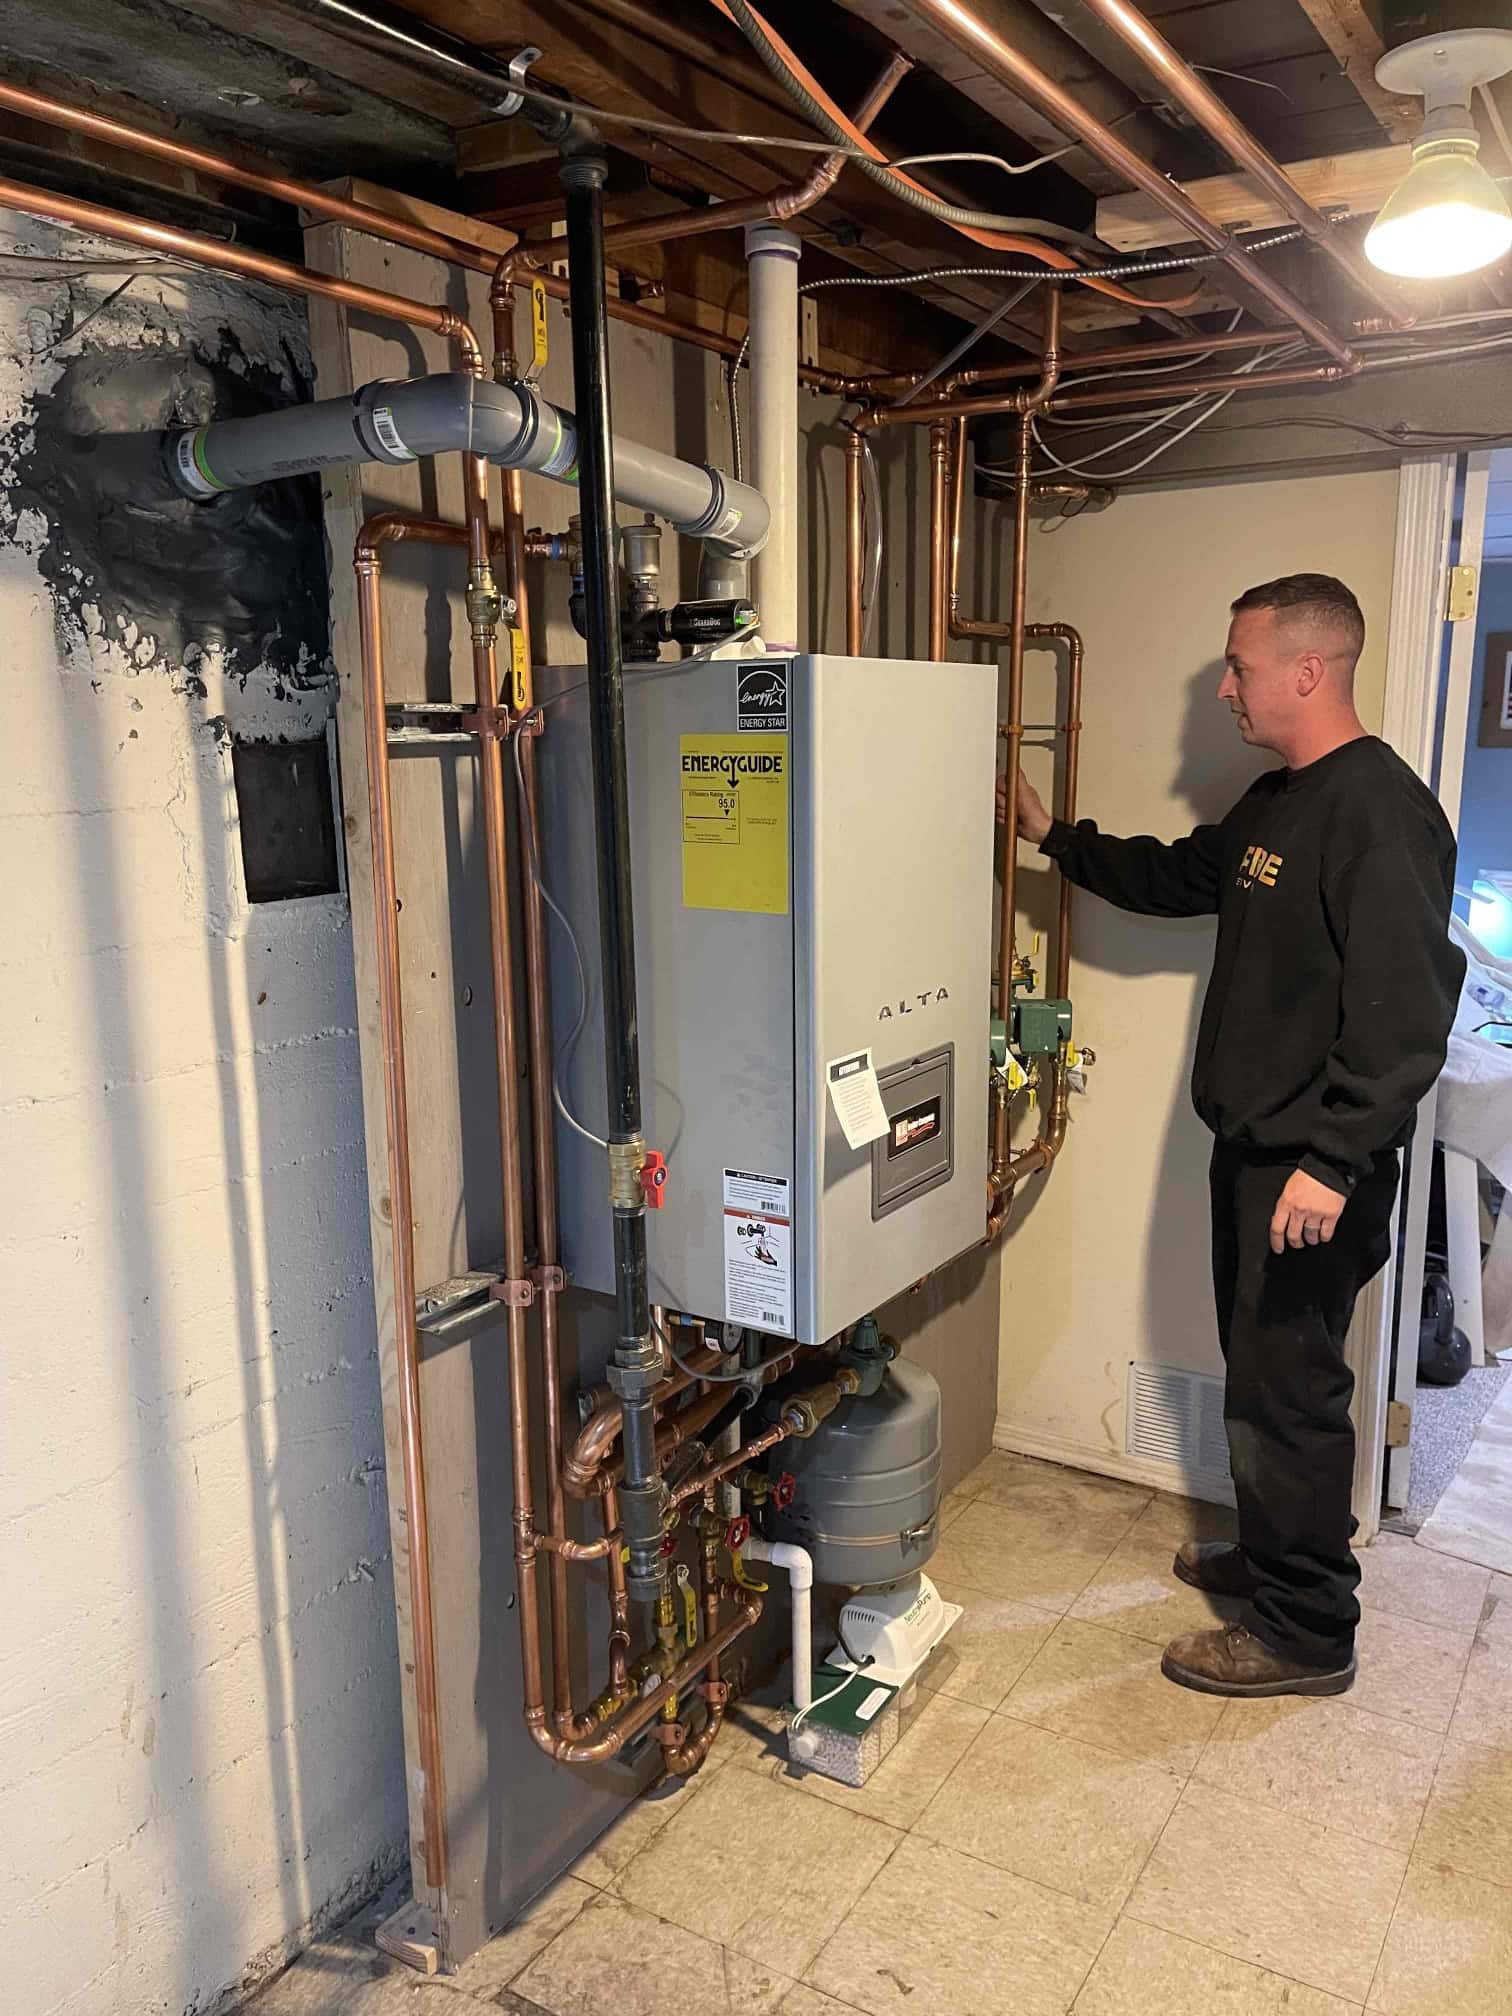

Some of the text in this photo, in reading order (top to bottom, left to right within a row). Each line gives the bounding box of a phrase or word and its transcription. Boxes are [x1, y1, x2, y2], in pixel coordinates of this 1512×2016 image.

[740, 717, 785, 728] ENERGY STAR
[682, 754, 783, 775] ENERGYGUIDE
[718, 798, 735, 809] 95.0
[878, 987, 949, 1021] ALTA
